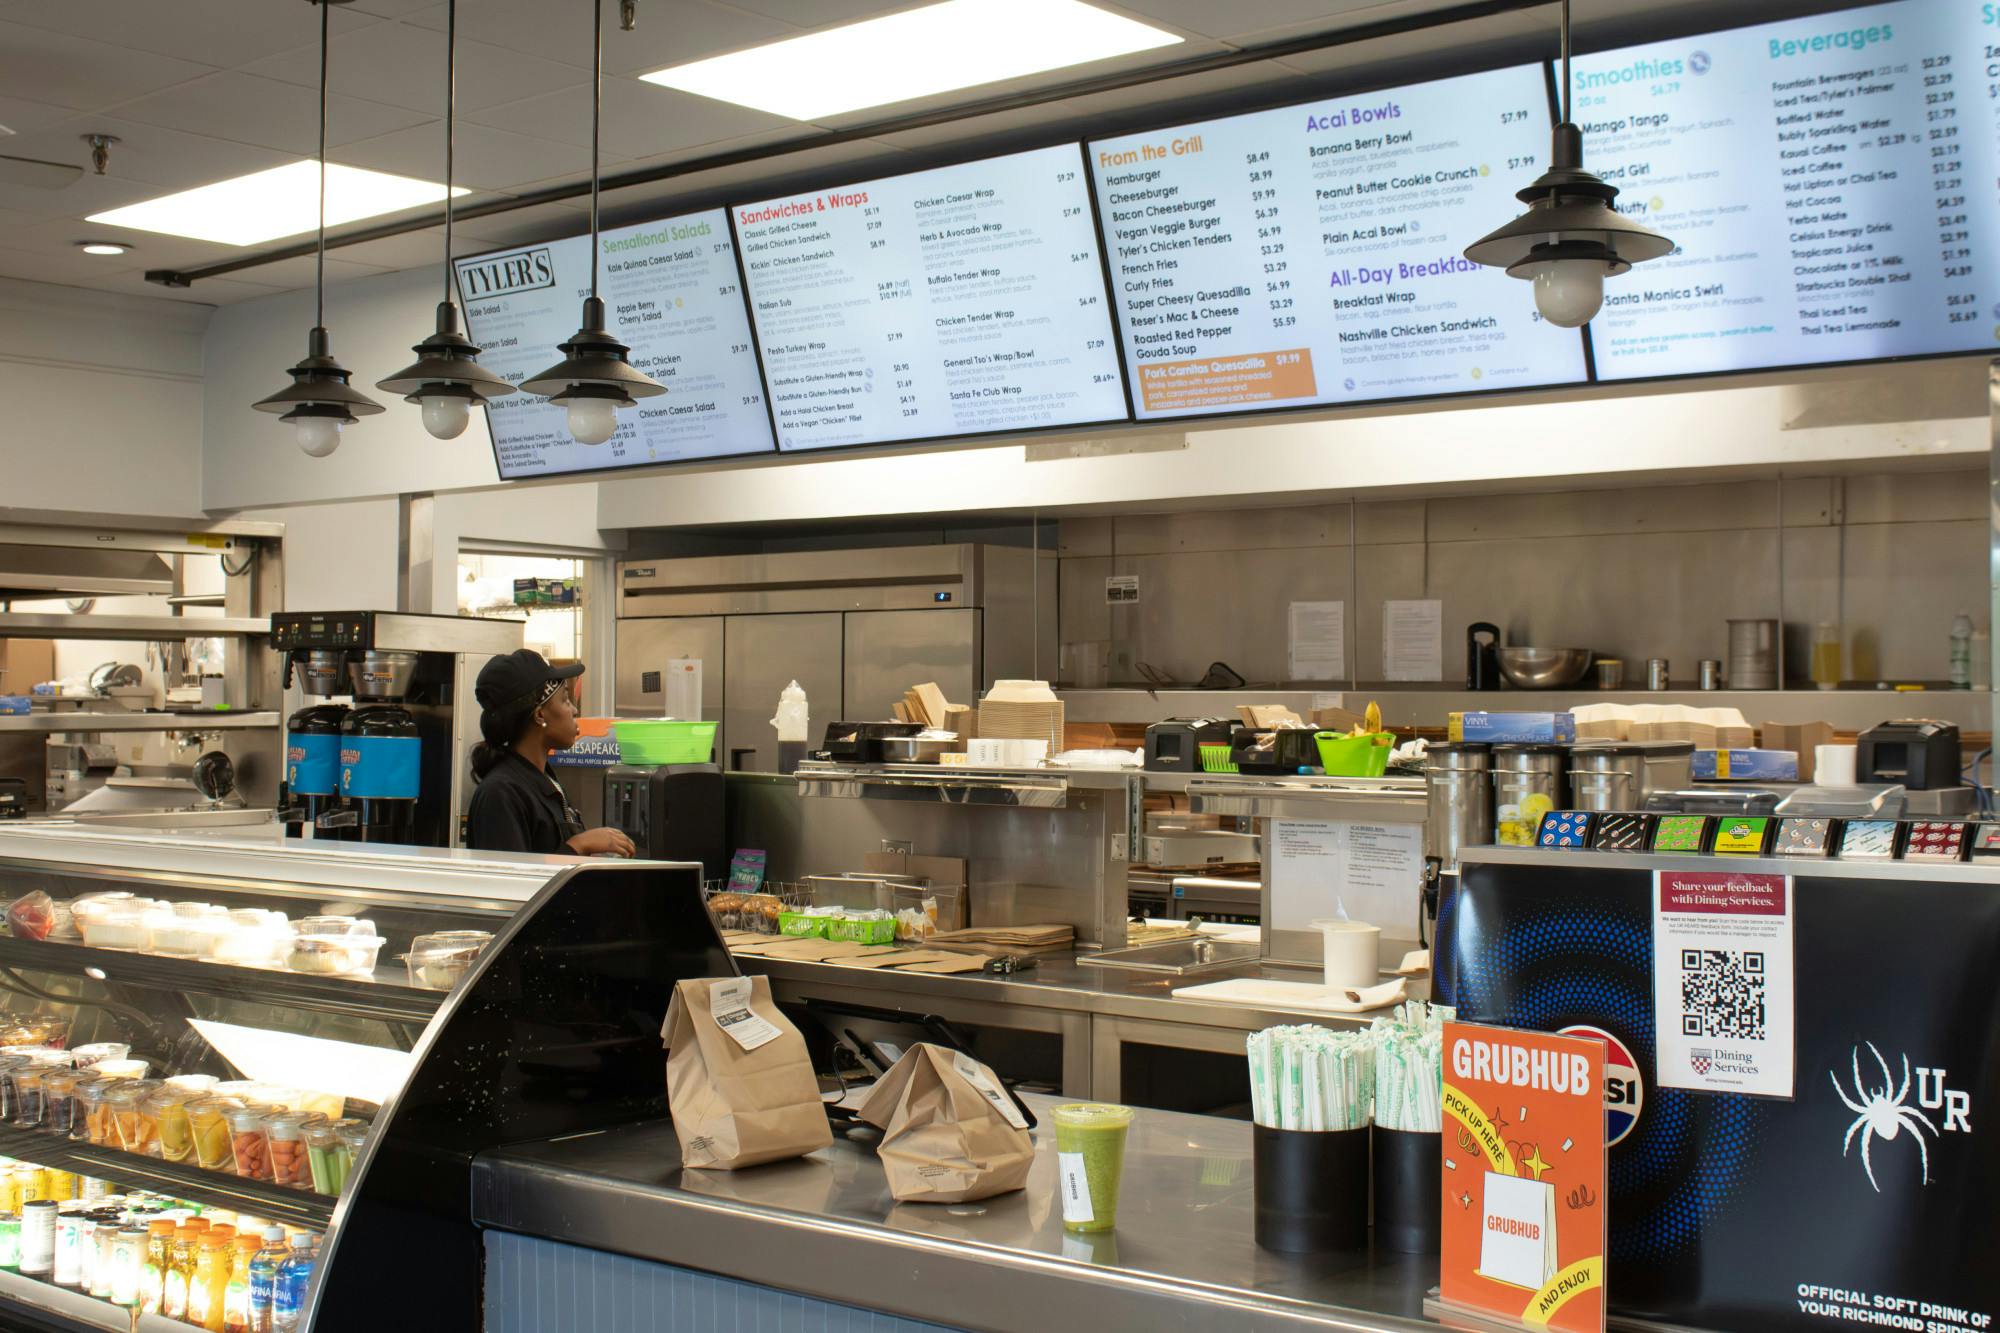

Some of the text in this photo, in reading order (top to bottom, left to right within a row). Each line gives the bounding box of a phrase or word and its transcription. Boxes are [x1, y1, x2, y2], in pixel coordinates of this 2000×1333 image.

[1769, 25, 1892, 59] Beverages
[1575, 59, 1684, 90] Smoothies
[1306, 101, 1401, 133] Acai Bowls
[1583, 113, 1669, 135] Mango Tango
[1309, 110, 1528, 158] Banana Berry Bowl $7.99
[1100, 136, 1202, 168] From the Grill
[1106, 151, 1270, 186] Hamburger $8.49
[1315, 156, 1535, 200] Peanut Butter Cookie Crunch $7.99
[1782, 161, 1843, 176] Iced Coffee
[914, 172, 1075, 209] Chicken Caesar Wrap $9.29
[1109, 169, 1273, 205] Cheeseburger $8.99
[740, 192, 868, 225] Sandwiches & Wraps
[1112, 188, 1276, 222] Bacon Cheeseburger $9.99
[1806, 196, 1842, 207] Cocoa
[919, 207, 1081, 242] Herb & Avocado Wrap $7.49
[1114, 207, 1279, 241] Vegan Veggie Burger $6.39
[1788, 212, 1848, 225] Yerba Mate
[603, 222, 711, 254] Sensational Salads
[747, 231, 831, 252] Grilled Chicken Sandwich
[1117, 225, 1282, 259] Tyler's Chicken Tenders $6.99
[1322, 223, 1408, 244] Plain Acai Bowl
[1791, 232, 1826, 243] Celsius
[1828, 228, 1864, 238] Energy
[607, 250, 694, 272] Kale Quinoa Caesar Salad
[1121, 259, 1178, 275] French Fries
[463, 252, 550, 296] TYLER'S
[927, 268, 1001, 286] Buffalo Tender Wrap
[1124, 261, 1287, 292] Curly Fries $3.29
[1330, 267, 1393, 288] All-Day
[1127, 285, 1252, 311] Super Cheesy Quesadilla
[1333, 292, 1416, 309] Breakfast Wrap
[1605, 283, 1724, 307] Santa Monica Swirl
[617, 301, 655, 314] Apple Berry
[619, 311, 662, 325] Cherry Salad
[935, 310, 1015, 327] Chicken Tender Wrap
[1130, 306, 1240, 327] Reser's Mac & Cheese
[1822, 307, 1846, 317] Iced
[1848, 305, 1868, 314] Tea
[1133, 316, 1296, 345] Roasted Red Pepper $5.59
[1338, 316, 1497, 343] Nashville Chicken Sandwich
[767, 342, 826, 355] Pesto Turkey Wrap
[943, 356, 974, 368] General
[992, 349, 1035, 362] Wrap/Bowl
[1136, 344, 1197, 360] Gouda Soup
[1145, 366, 1166, 379] Pork
[1168, 364, 1209, 376] Carnitas
[1211, 358, 1265, 372] Quesadilla
[949, 386, 1022, 400] Santa Fe Club Wrap
[639, 402, 715, 419] Chicken Caesar Salad
[1465, 717, 1488, 726] VINYL
[563, 742, 620, 755] HESAPEAKE
[1672, 881, 1773, 894] Share your feedback
[1672, 894, 1774, 907] with Dining Services.
[1452, 1038, 1590, 1096] GRUBHUB
[1715, 1049, 1752, 1063] Dining
[1714, 1061, 1759, 1074] Services
[1916, 1067, 1971, 1133] UR
[1446, 1093, 1504, 1163] PICK UP HERE
[1487, 1215, 1540, 1240] GRUBHUB
[1539, 1268, 1591, 1315] AND ENJOY
[1797, 1284, 1991, 1328] OFFICIAL SOFT DRINK OF
[1798, 1300, 1840, 1318] YOUR
[1843, 1306, 1924, 1332] RICHMOND
